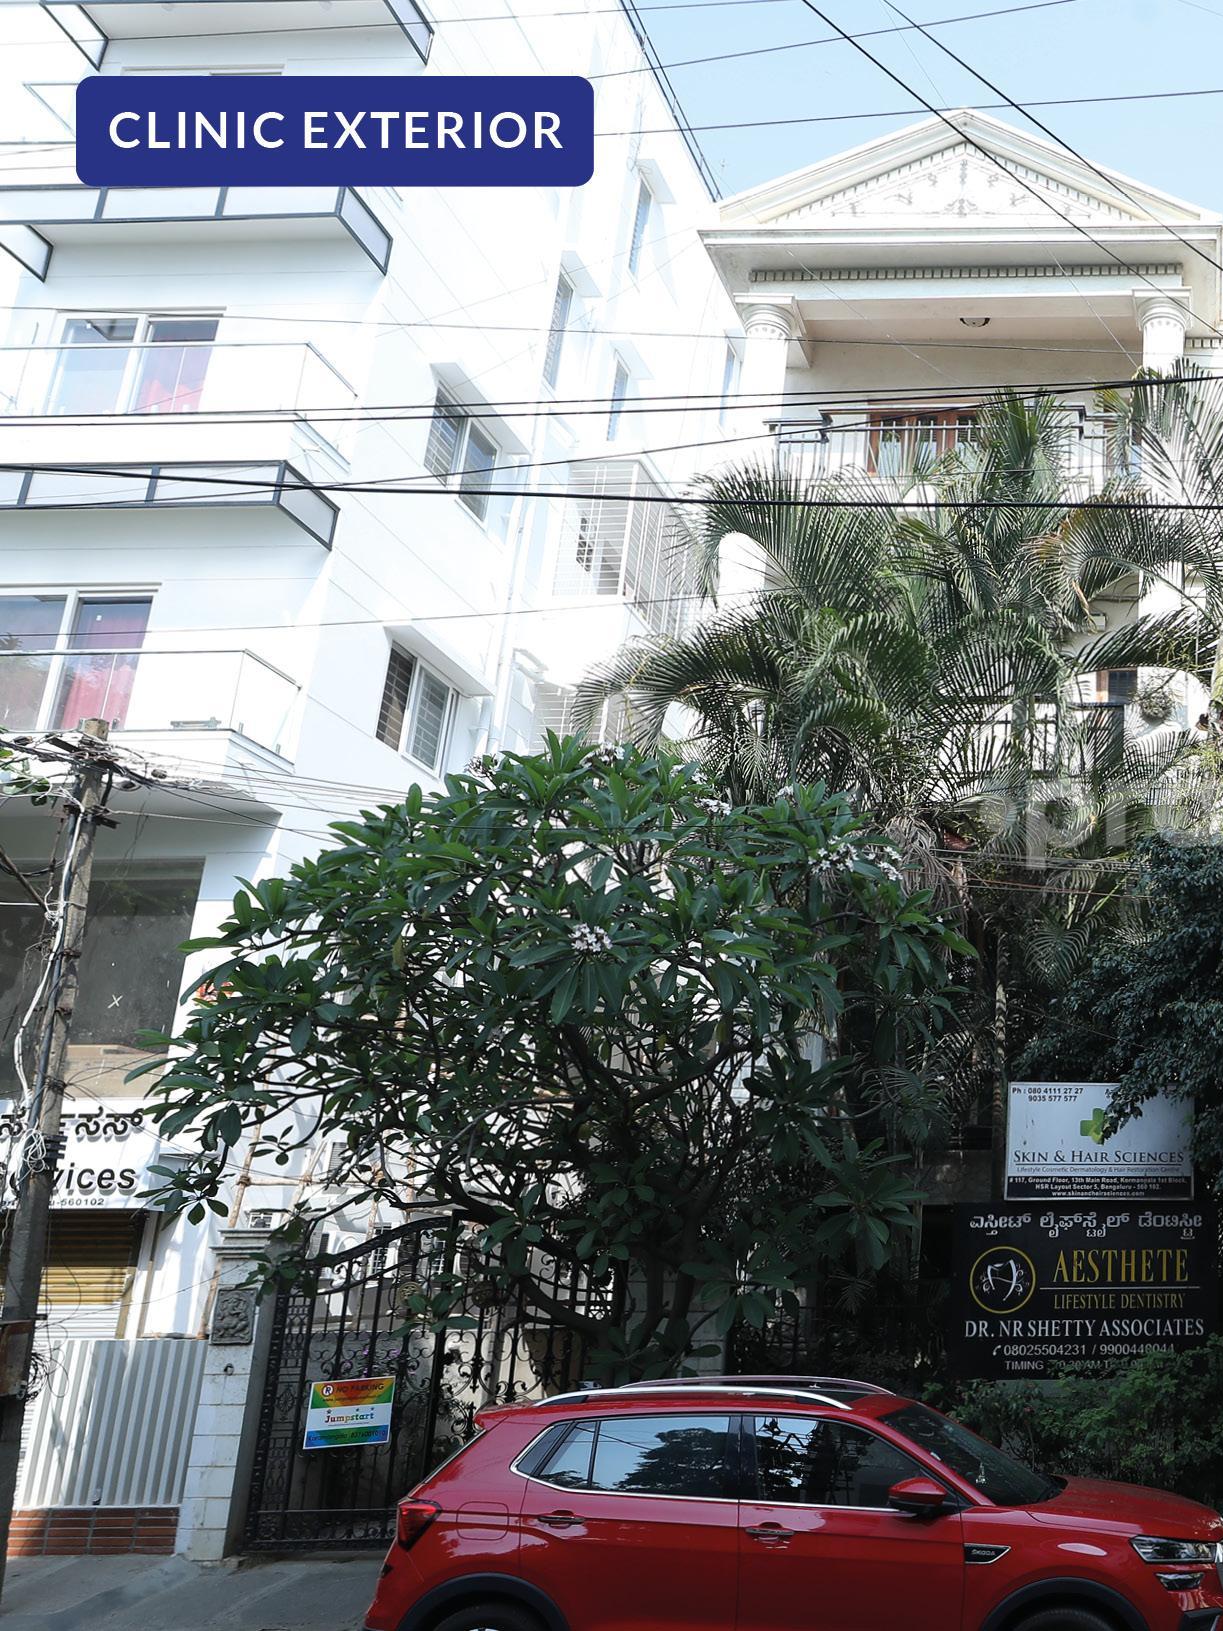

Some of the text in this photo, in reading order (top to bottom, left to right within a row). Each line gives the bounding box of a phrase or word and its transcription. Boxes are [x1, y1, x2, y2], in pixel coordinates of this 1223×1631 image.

[1013, 1150, 1184, 1163] SKIN & HAIR SCIENCES
[1017, 1166, 1041, 1174] Lifestyle
[1069, 1166, 1108, 1174] Dermatology
[1053, 1249, 1189, 1282] AESTHETE
[1054, 1293, 1185, 1309] LIFESTYLE DENTISTRY
[965, 1318, 1204, 1338] DR. NR SHETTY ASSOCIATES
[1003, 1344, 1086, 1356] 08025504231
[1005, 1360, 1044, 1370] TIMING
[351, 1383, 384, 1391] PARKING
[324, 1412, 374, 1424] Jumpstart
